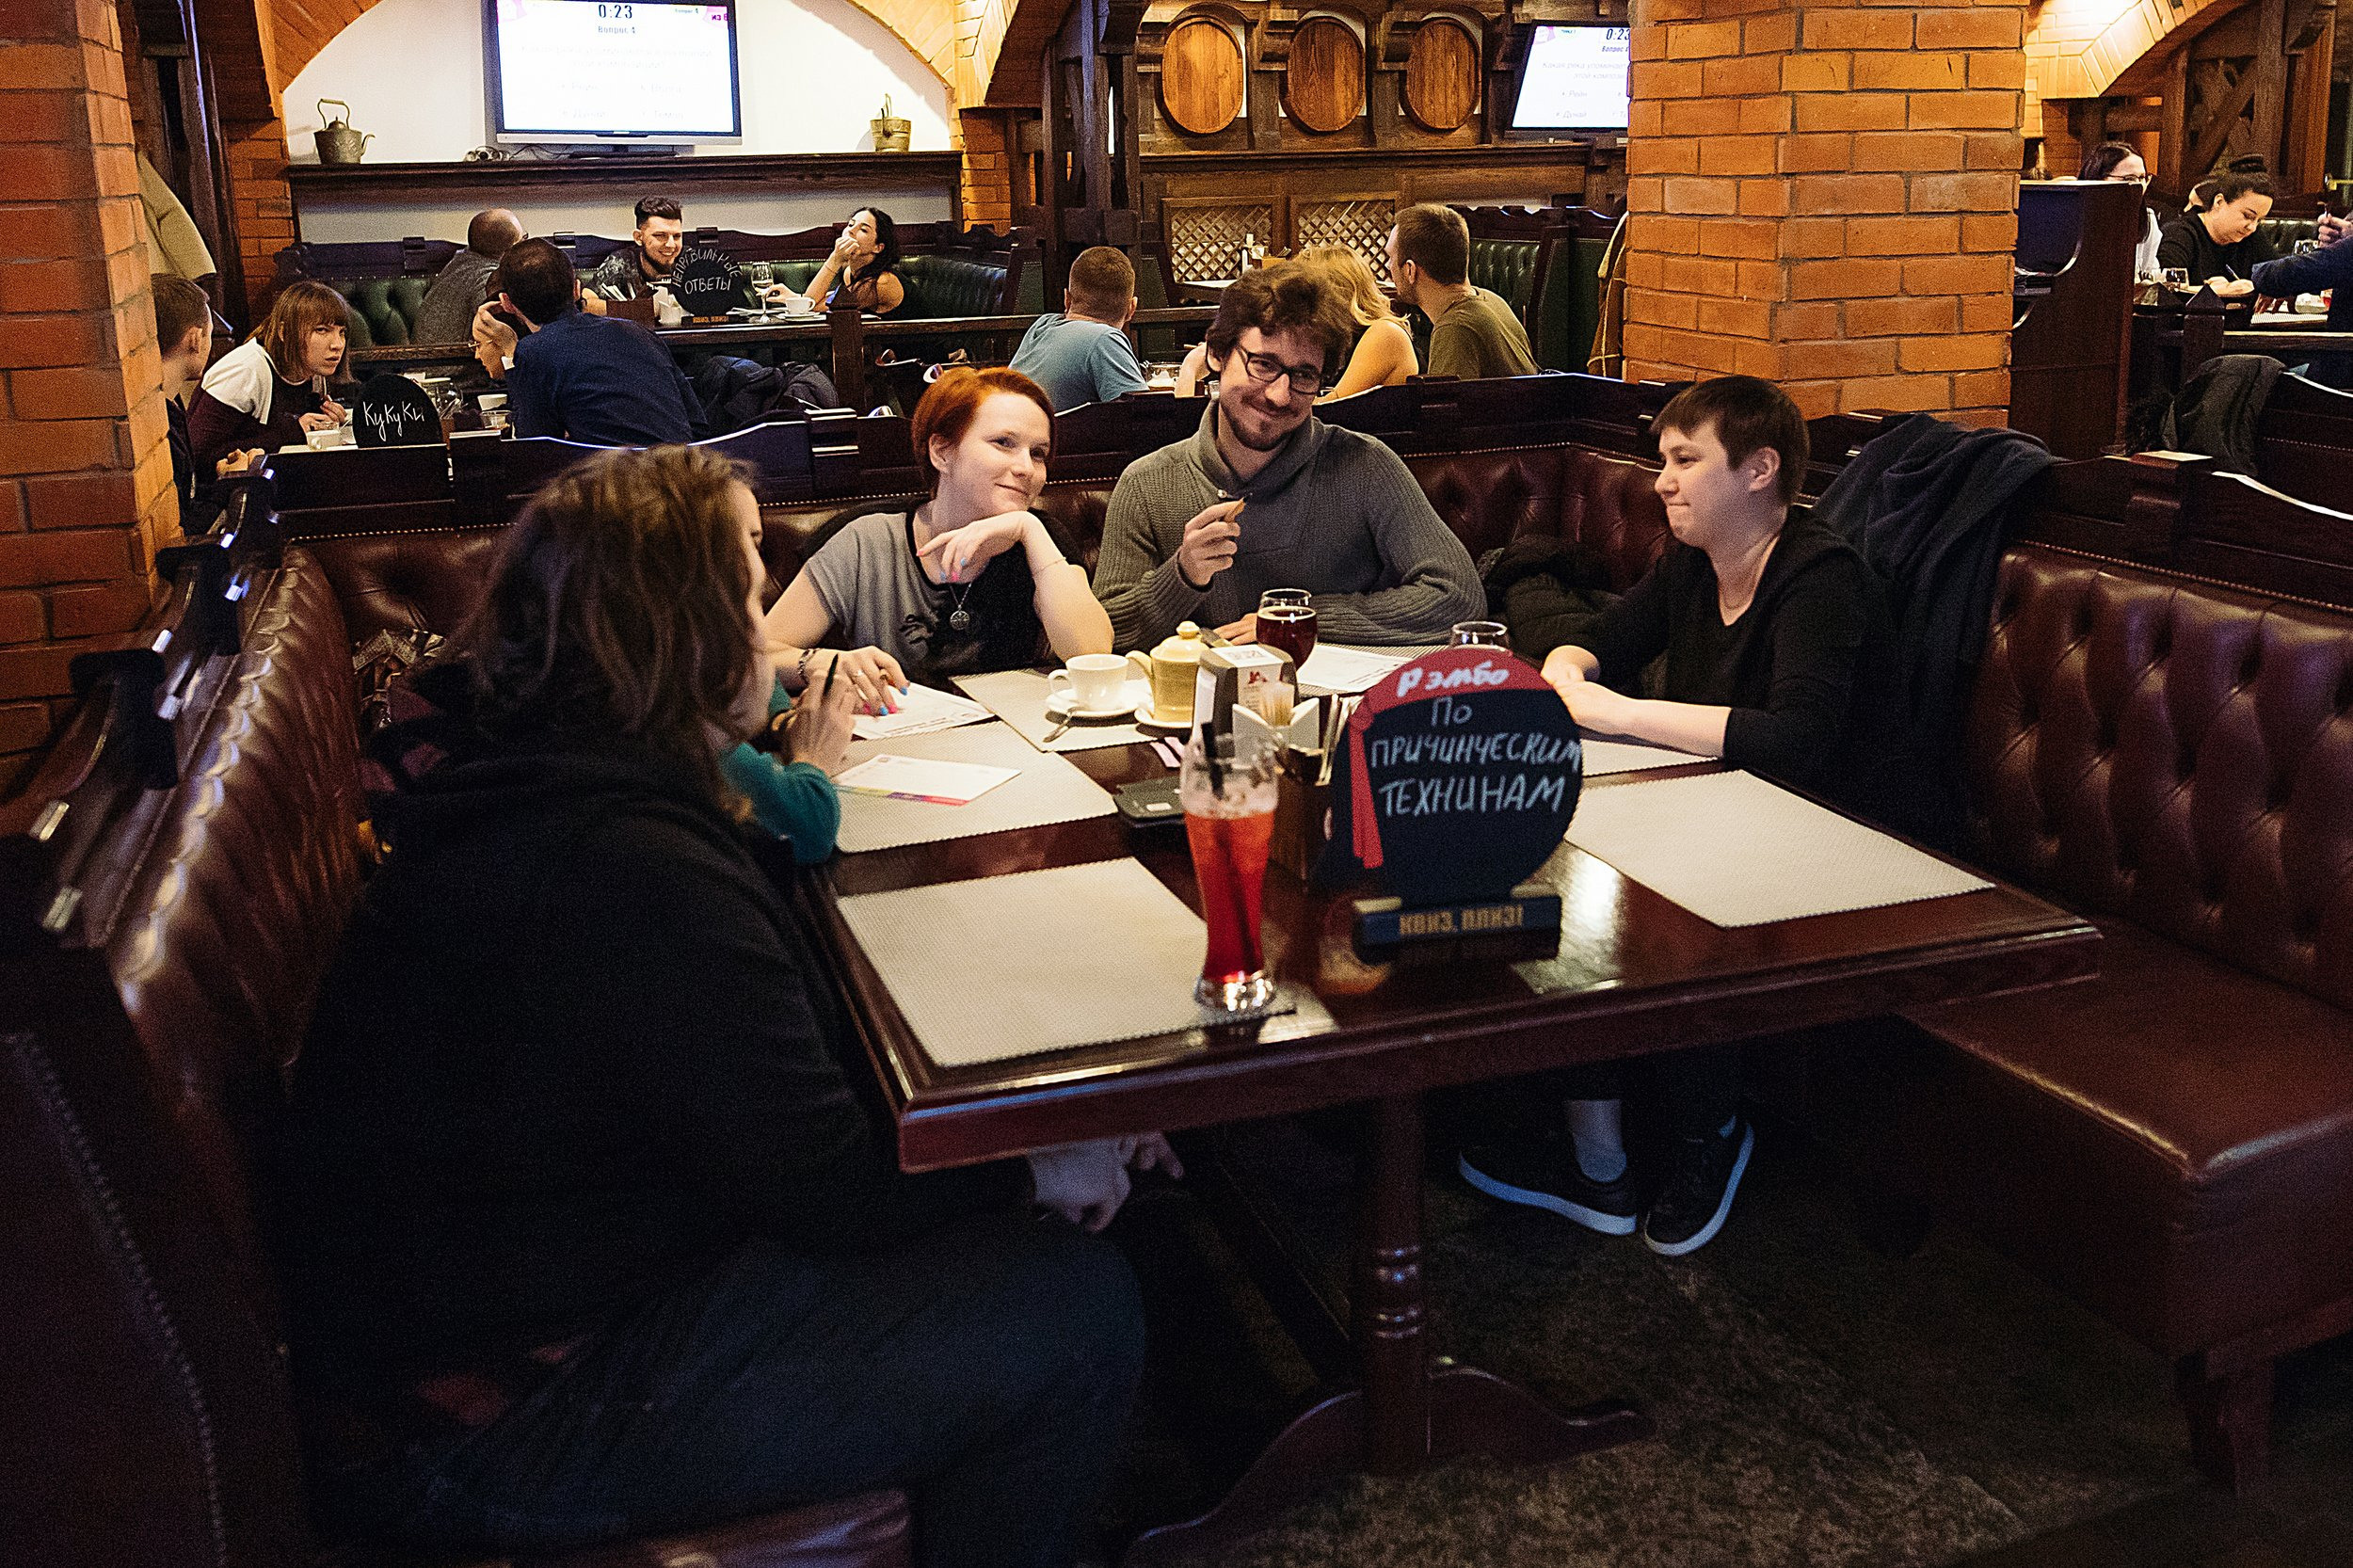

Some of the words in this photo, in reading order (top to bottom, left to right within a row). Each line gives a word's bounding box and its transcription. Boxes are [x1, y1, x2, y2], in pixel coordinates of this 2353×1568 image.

[598, 4, 632, 19] 0:23
[684, 276, 731, 295] ОТВЕТЫ
[1396, 660, 1510, 697] Рэмбо
[1370, 732, 1582, 773] ПРИЧИНЧЕСКИМ
